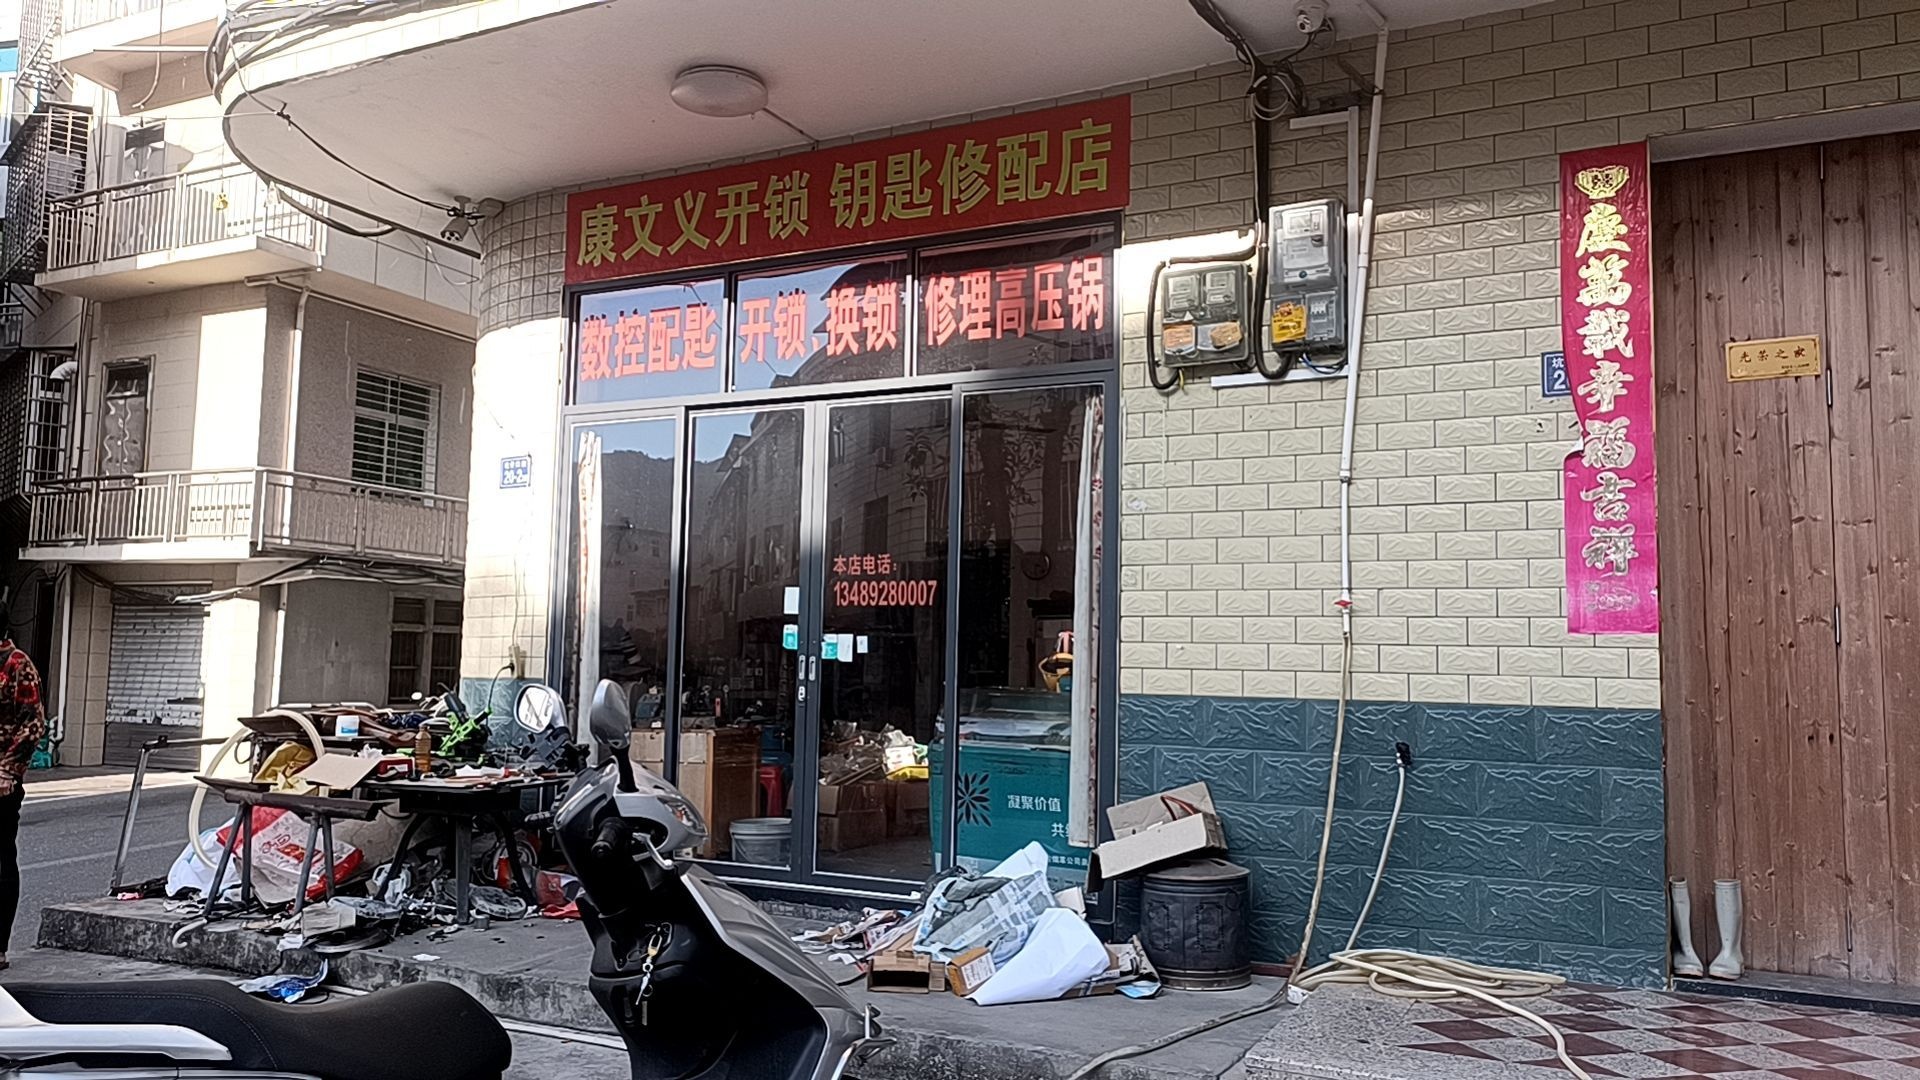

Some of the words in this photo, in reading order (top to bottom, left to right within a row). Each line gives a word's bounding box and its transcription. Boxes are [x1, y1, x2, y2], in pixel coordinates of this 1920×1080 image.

[577, 170, 809, 267] 康文义开锁
[830, 118, 1112, 229] 钥匙修配店
[580, 302, 717, 382] 数控配匙
[924, 256, 1105, 347] 修理高压锅
[833, 553, 897, 576] 本店电话：
[834, 580, 937, 606] 13489280007
[1007, 795, 1061, 812] 凝聚价值
